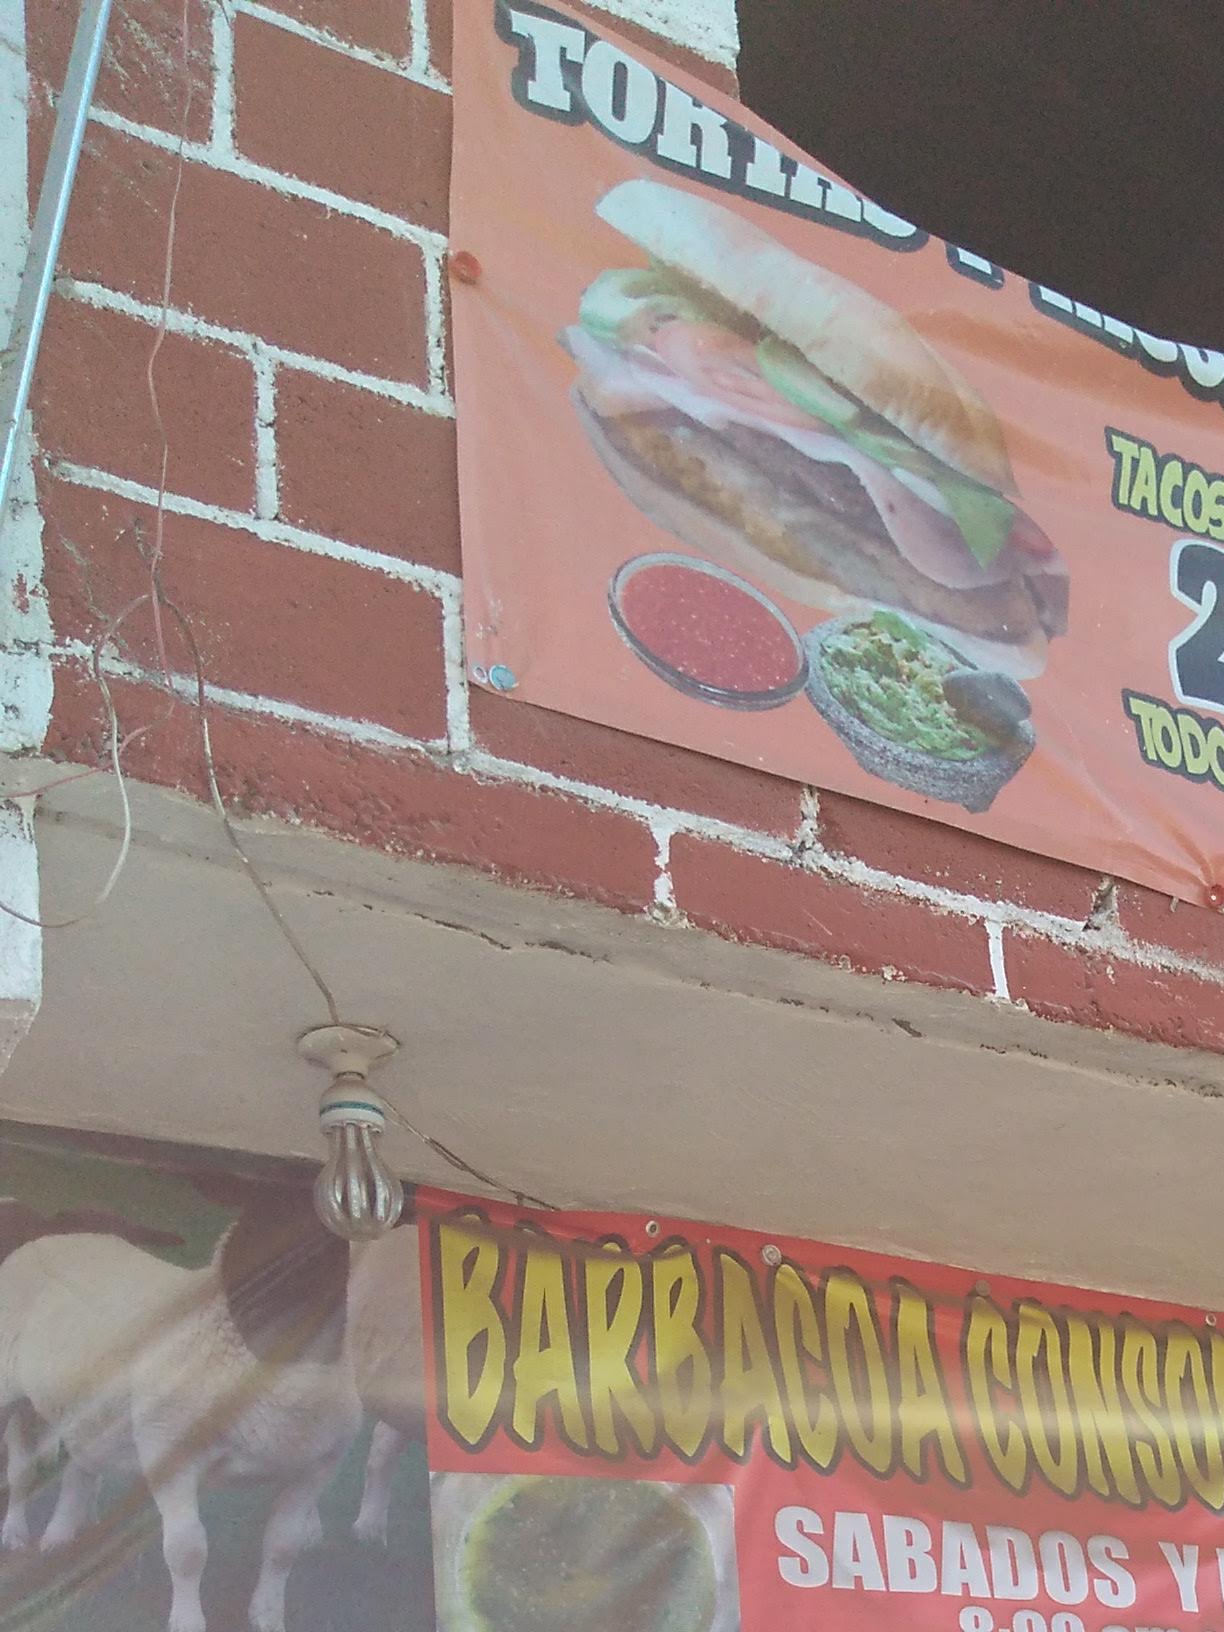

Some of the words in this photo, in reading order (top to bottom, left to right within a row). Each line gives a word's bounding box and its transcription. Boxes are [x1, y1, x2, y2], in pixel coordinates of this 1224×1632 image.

[439, 1213, 965, 1485] BARBACOA
[774, 1505, 1137, 1610] SABADOS
[1159, 1541, 1200, 1614] Y
